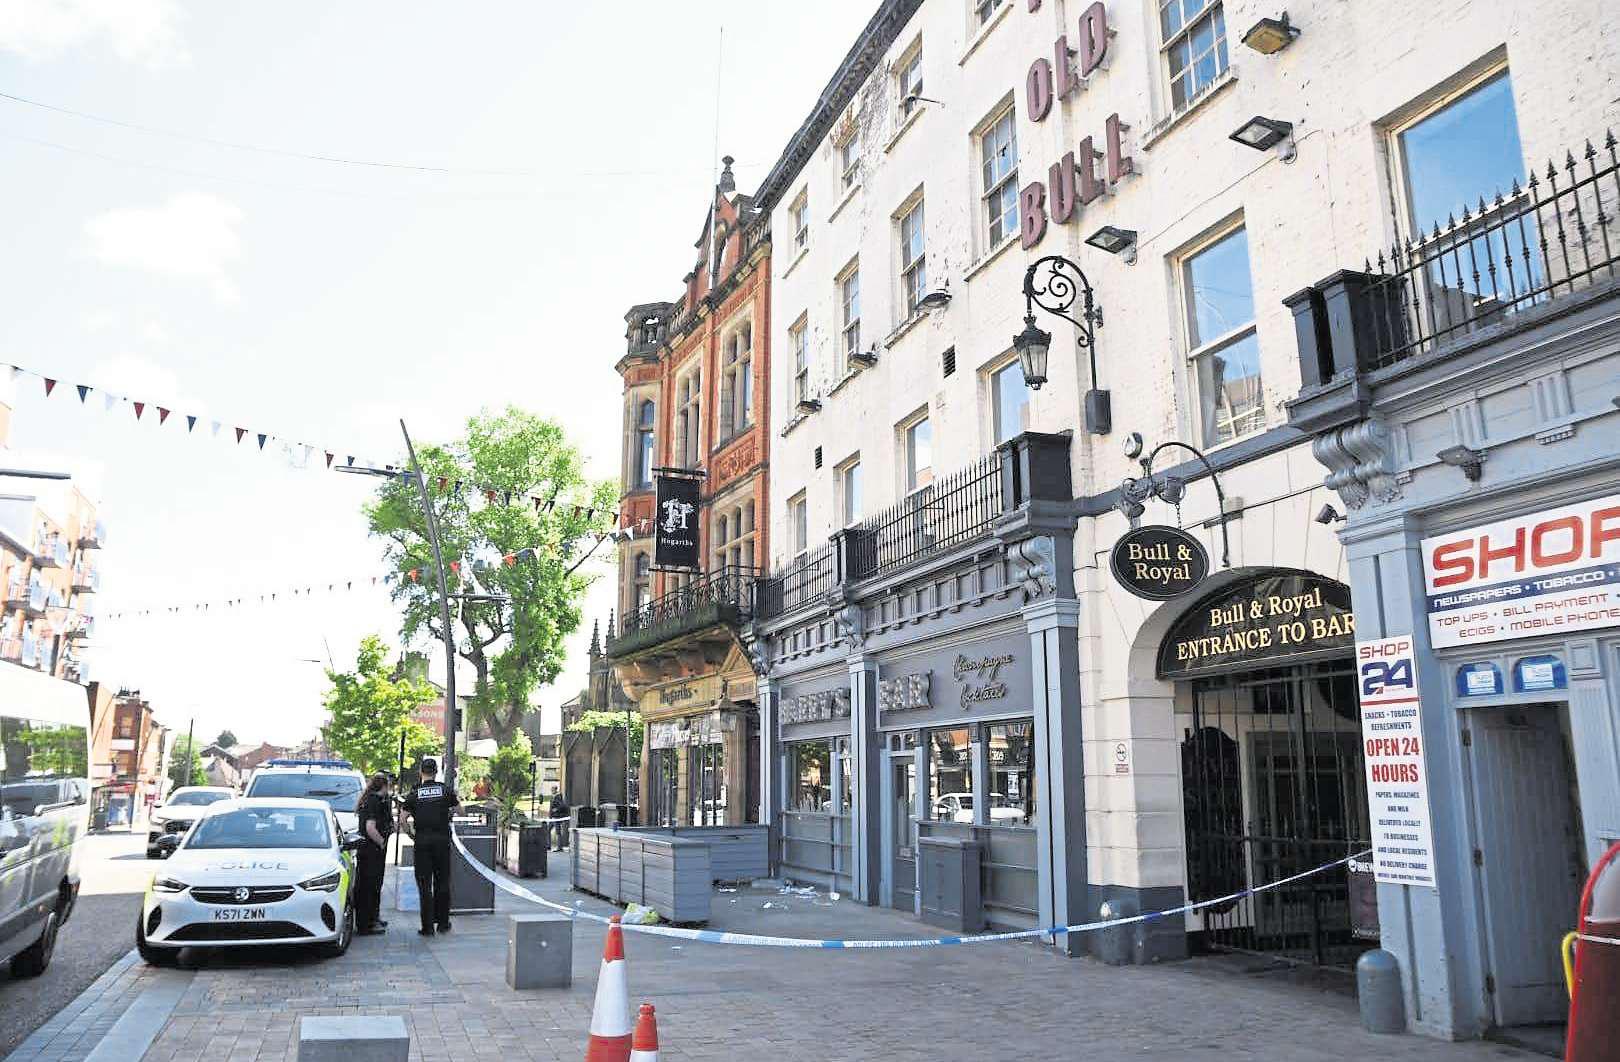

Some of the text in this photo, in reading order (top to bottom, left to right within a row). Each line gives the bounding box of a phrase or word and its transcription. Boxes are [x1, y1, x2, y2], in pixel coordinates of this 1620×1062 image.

[1026, 1, 1108, 122] OLD
[1020, 113, 1133, 250] BULL
[1129, 543, 1193, 561] Bull &
[1136, 563, 1191, 585] Royal
[1434, 584, 1522, 609] NEWSPAPERS
[1533, 570, 1605, 591] TOBACCO
[1210, 588, 1322, 628] Bull & Royal
[1437, 593, 1609, 628] TOP UPS BILL PAYMENT
[1176, 613, 1355, 662] ENTRANCE TO BAR
[1459, 626, 1496, 638] ECIGS
[1510, 615, 1564, 631] MOBILE
[1359, 641, 1409, 660] SHOP
[1362, 659, 1414, 696] 24
[1364, 708, 1417, 720] SNACKS TOBACCO
[1371, 722, 1412, 731] REFRESHMENTS
[1366, 736, 1420, 757] OPEN 24
[1371, 763, 1419, 783] HOURS
[418, 788, 441, 797] POLICE
[215, 909, 241, 920] KS71
